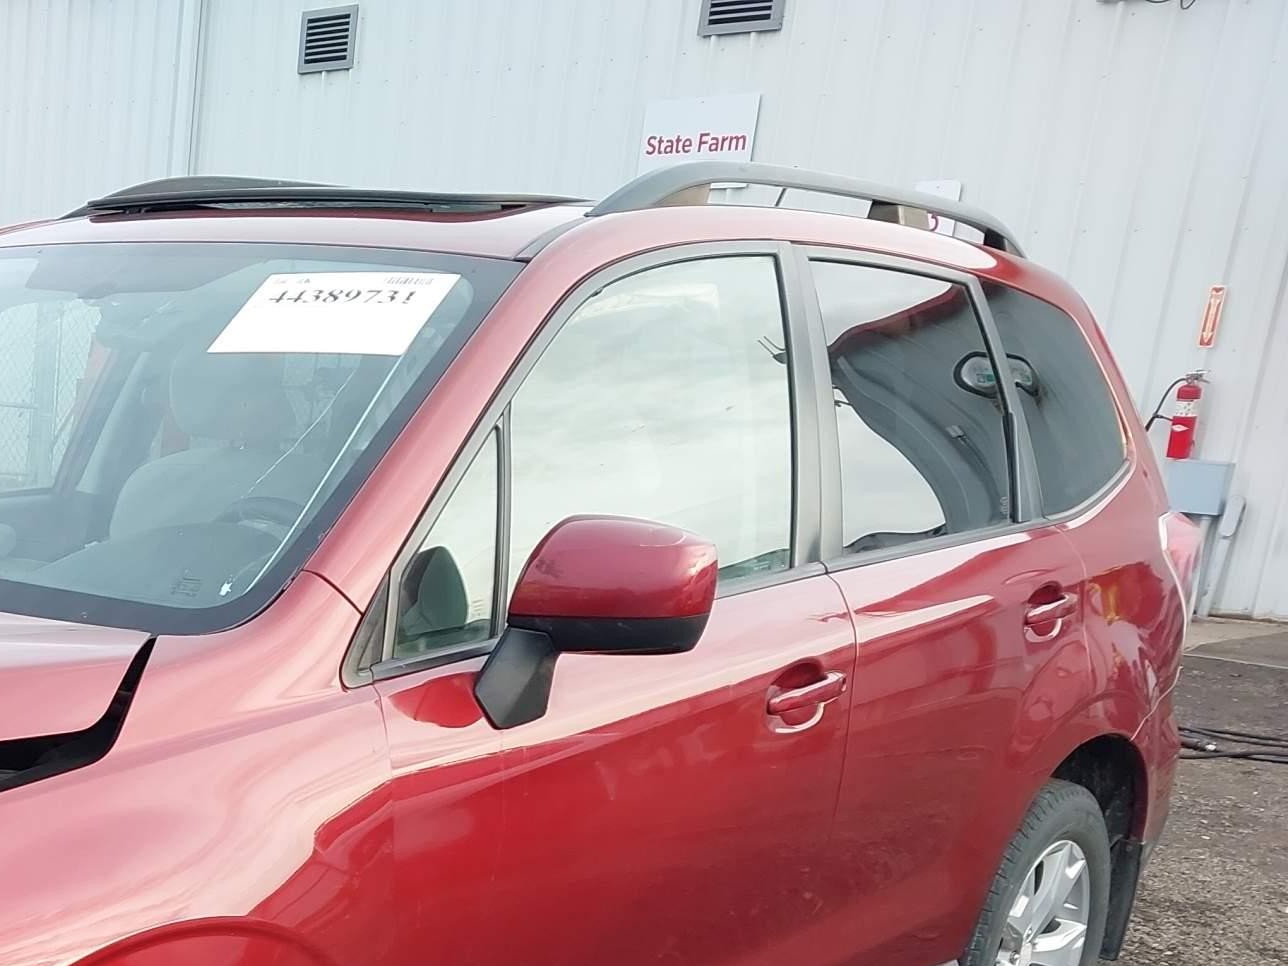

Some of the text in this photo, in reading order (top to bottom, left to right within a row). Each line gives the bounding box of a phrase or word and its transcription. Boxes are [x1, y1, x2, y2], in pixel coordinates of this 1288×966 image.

[645, 132, 747, 156] State Farm
[269, 289, 417, 304] 44389731
